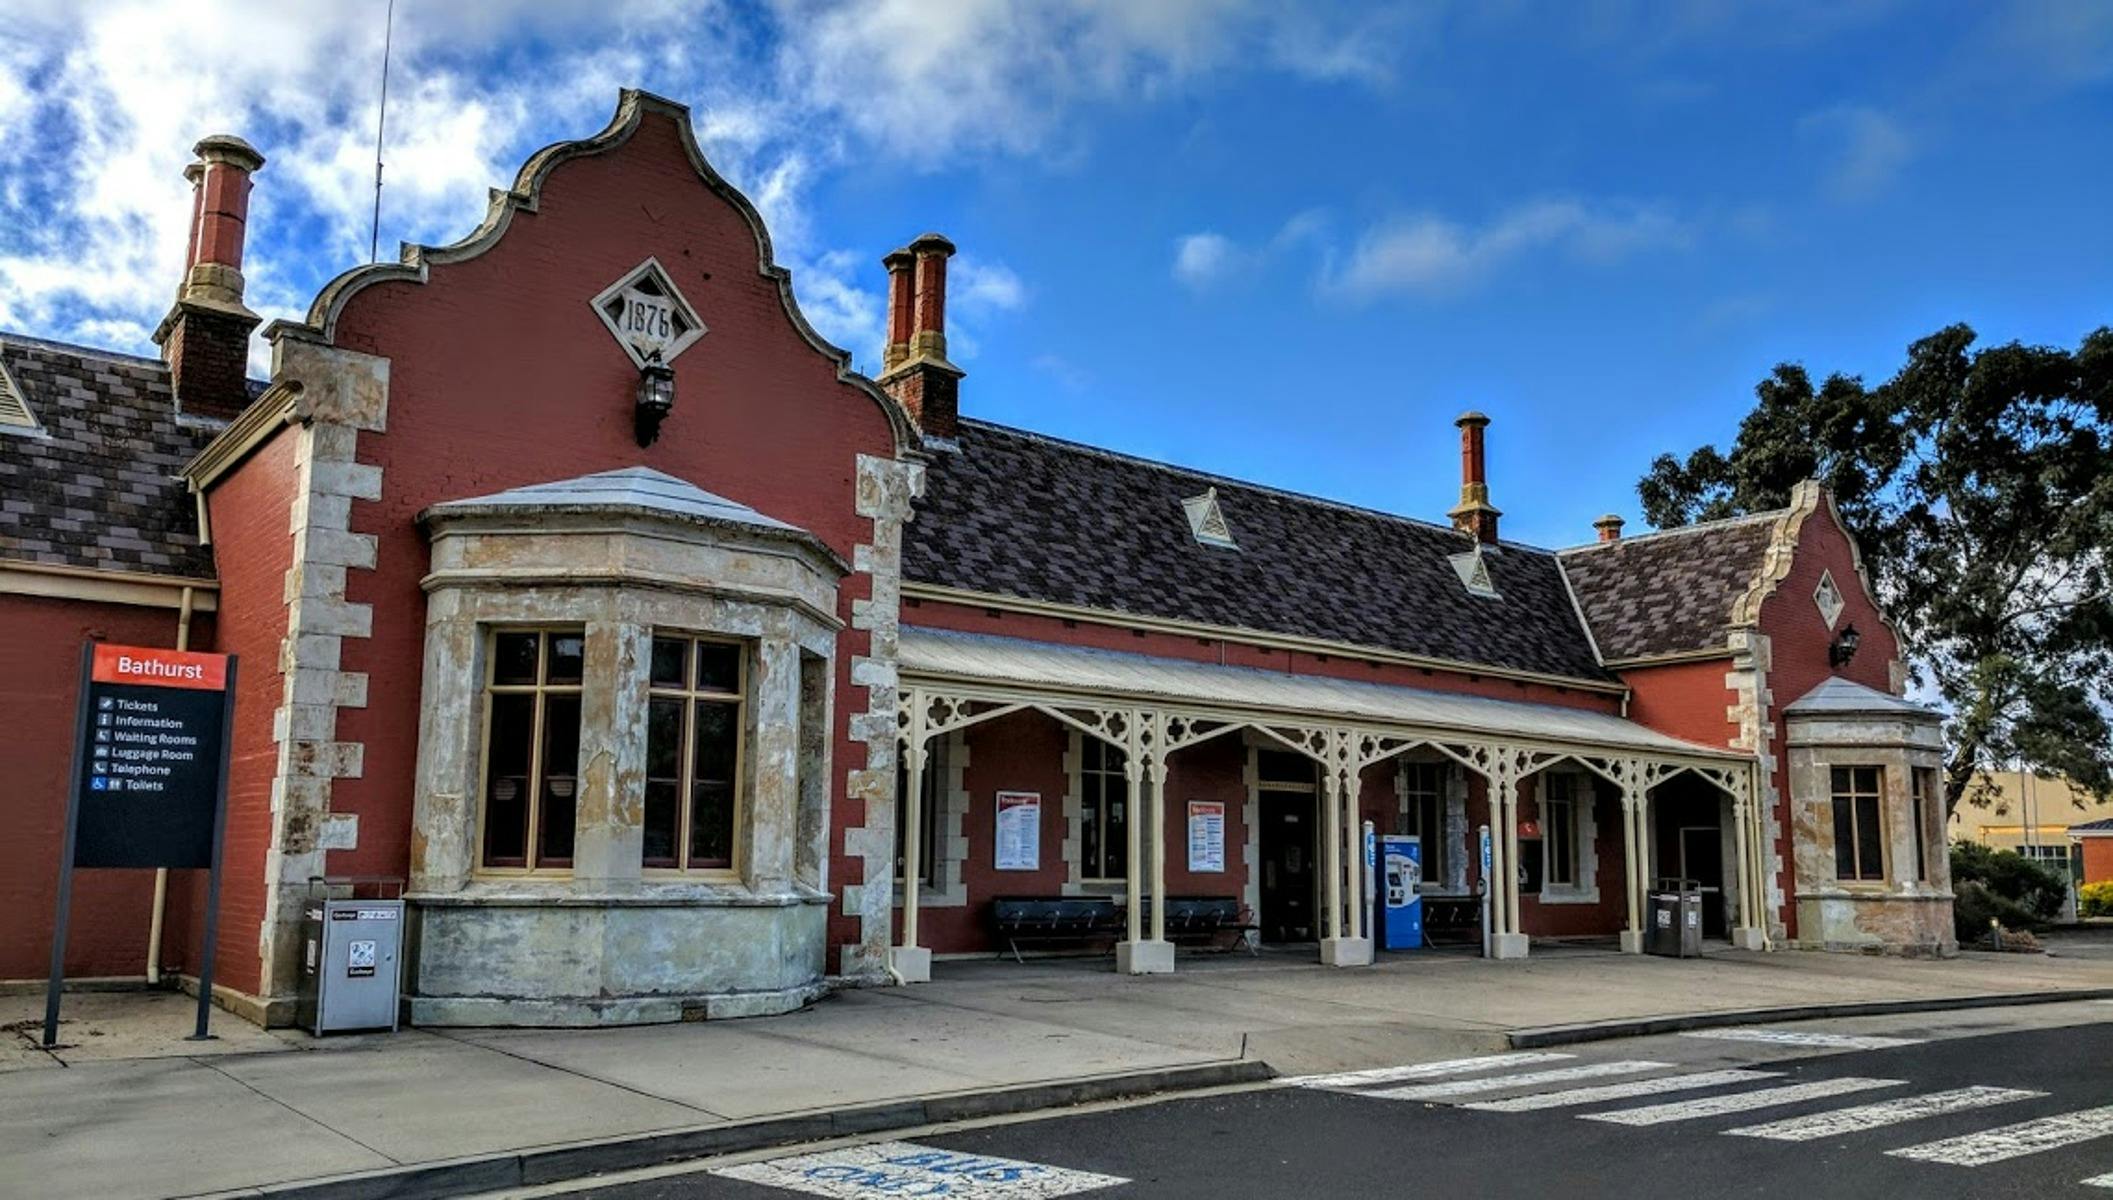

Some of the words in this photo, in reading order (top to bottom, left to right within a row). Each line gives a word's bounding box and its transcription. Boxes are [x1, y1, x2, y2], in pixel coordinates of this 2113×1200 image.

[627, 299, 670, 338] 1876
[118, 656, 203, 679] Bathurst
[117, 699, 158, 712] Tickets
[116, 715, 183, 729] Information
[114, 731, 158, 745] Waiting
[159, 733, 197, 745] Rooms
[112, 747, 160, 761] Luggage
[161, 749, 194, 760] Room
[111, 762, 171, 776] Telephone
[126, 779, 164, 791] Toilets
